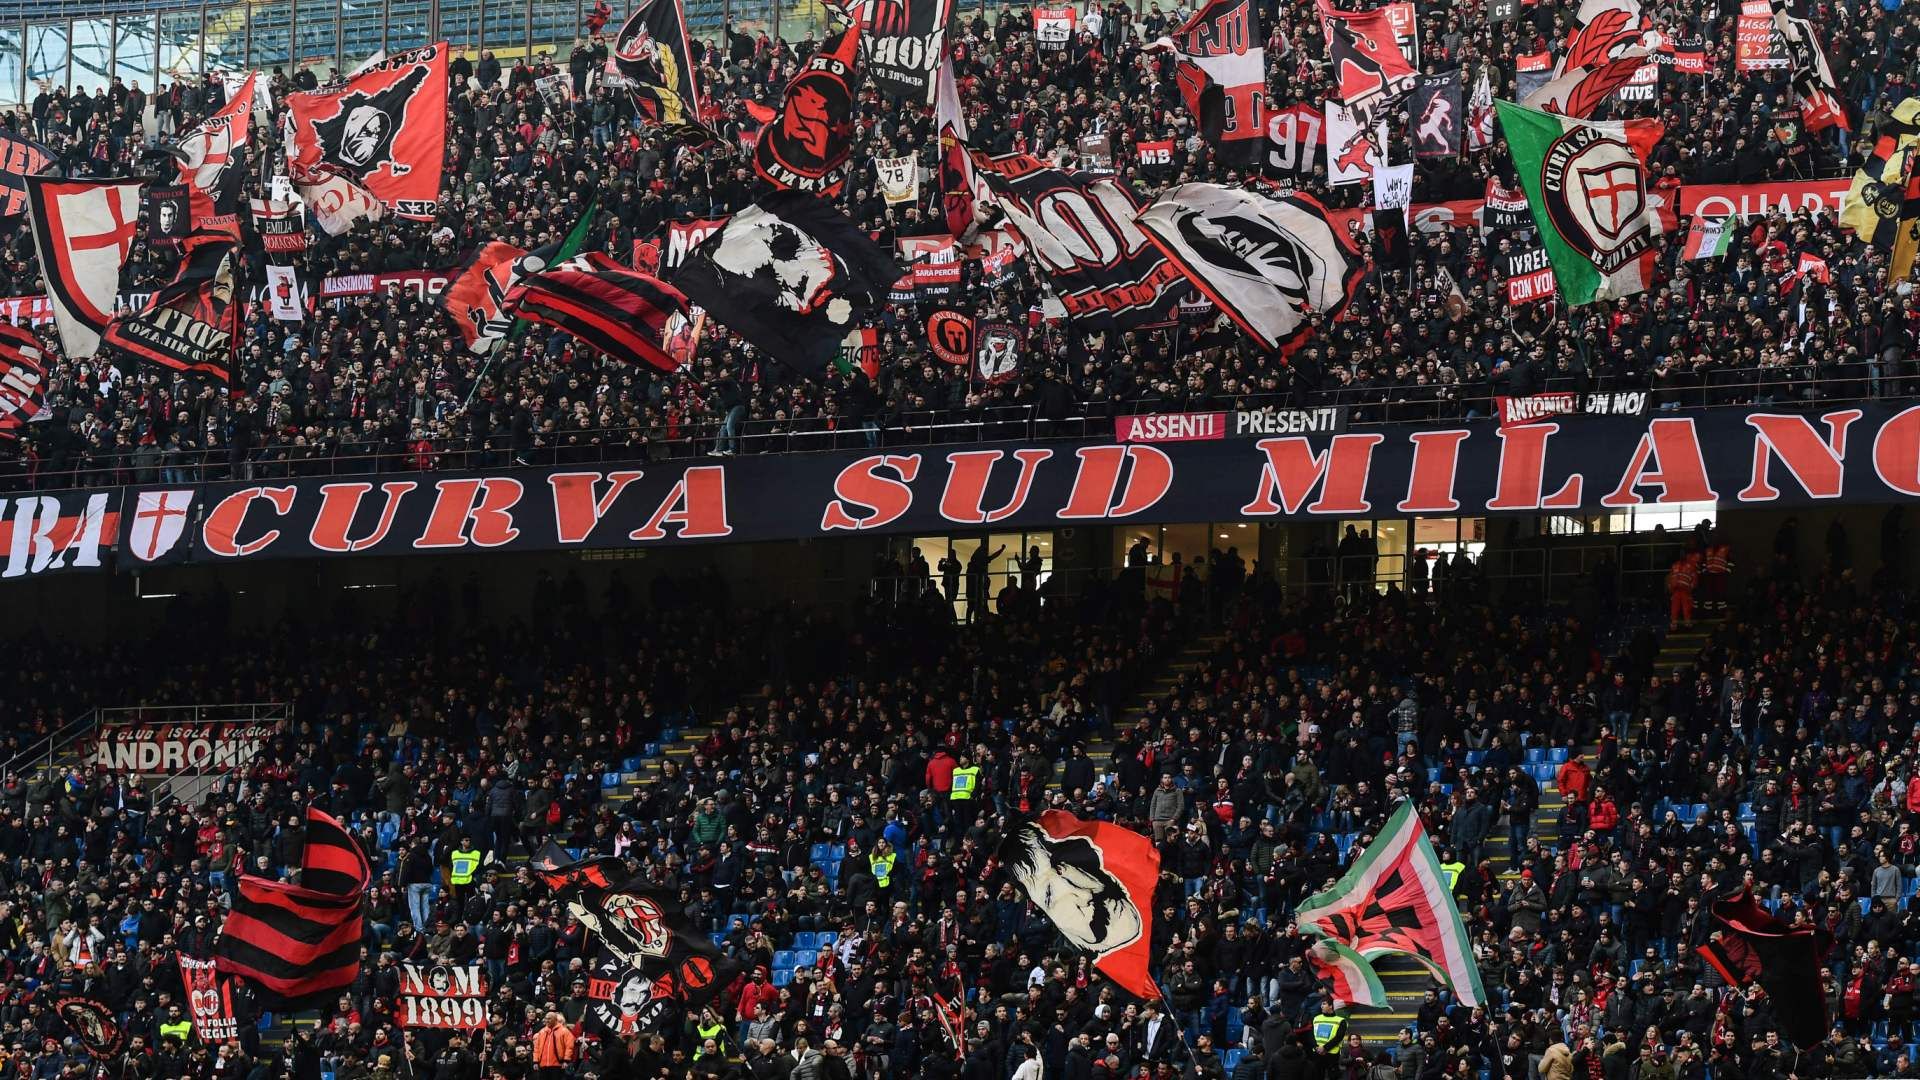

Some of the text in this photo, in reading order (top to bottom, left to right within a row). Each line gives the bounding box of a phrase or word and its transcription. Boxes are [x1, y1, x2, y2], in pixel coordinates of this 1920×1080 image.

[1646, 53, 1703, 68] ROSSONERA
[1620, 85, 1654, 100] VIVE
[1268, 111, 1321, 173] 97
[1141, 148, 1170, 165] MB
[1386, 177, 1402, 192] WHY
[266, 221, 292, 234] EMILIA
[263, 235, 304, 250] ROMAGNA
[324, 274, 374, 293] MASSIMONE
[933, 287, 949, 295] AMO
[1510, 271, 1554, 300] CON VOI
[1128, 407, 1337, 440] ASSENTI PRESENTI
[203, 465, 734, 557] CURVA
[820, 445, 1175, 532] SUD
[0, 493, 109, 578] BA
[168, 727, 210, 739] ISOLA
[404, 996, 483, 1027] 1899
